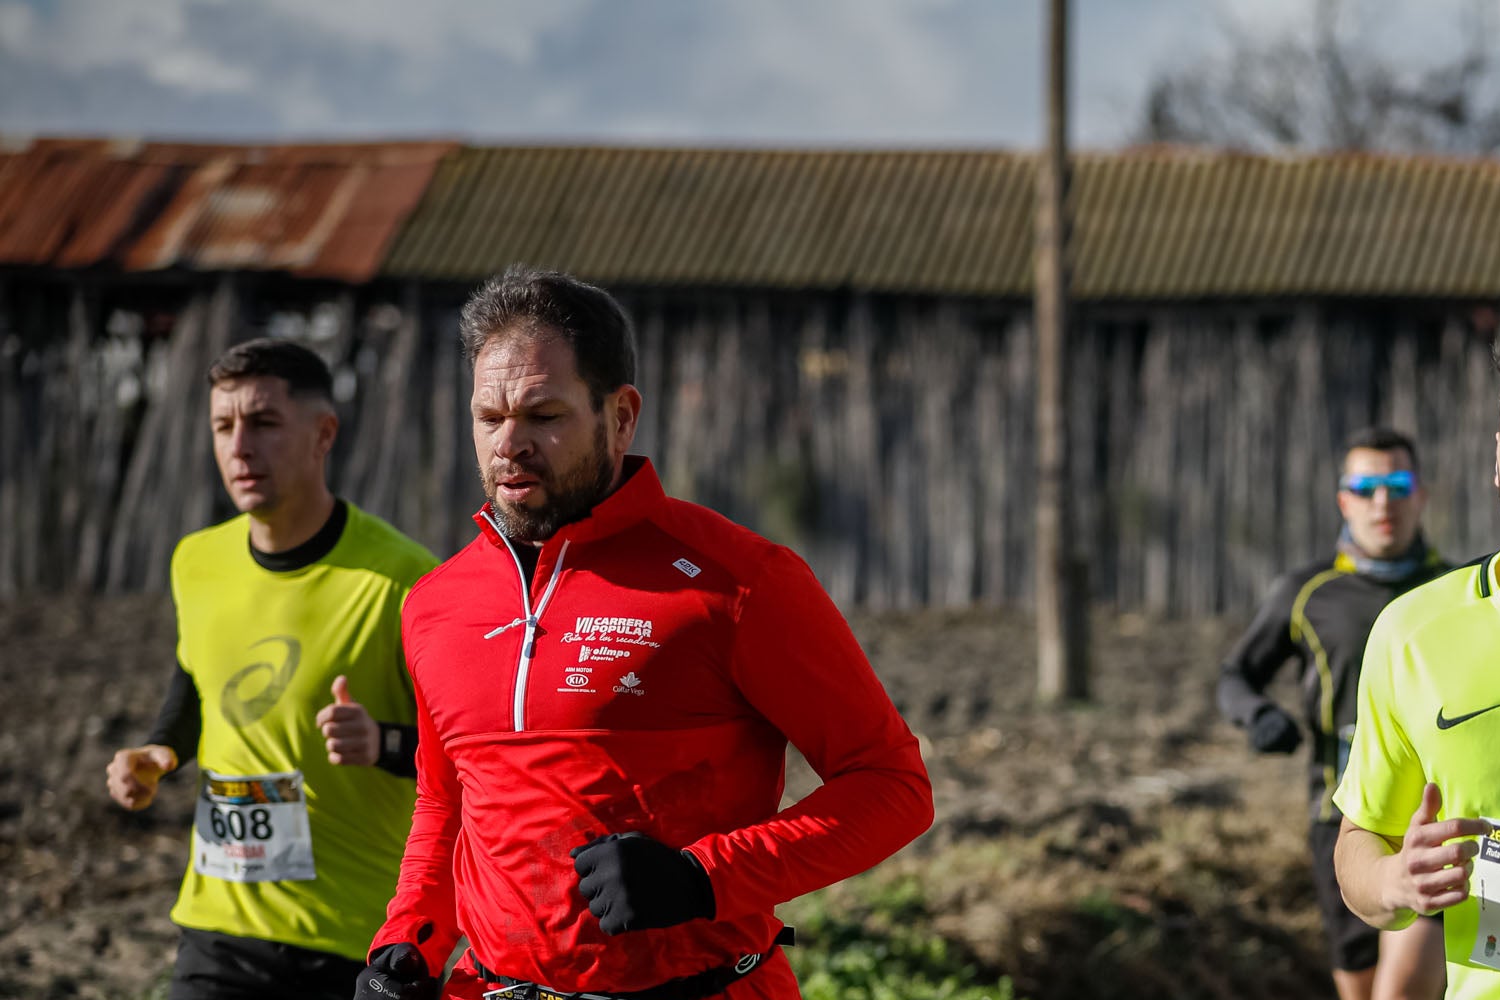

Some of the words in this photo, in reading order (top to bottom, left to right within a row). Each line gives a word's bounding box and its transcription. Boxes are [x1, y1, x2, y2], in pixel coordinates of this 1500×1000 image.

[575, 617, 594, 633] VII
[594, 617, 652, 630] CARRERA
[591, 625, 651, 637] POPULAR
[560, 632, 583, 643] Ruta
[585, 632, 597, 641] de
[599, 632, 613, 642] los
[616, 636, 660, 648] secaderos
[592, 647, 630, 658] olimpo
[569, 676, 584, 684] KIA
[210, 806, 273, 841] 608
[1485, 847, 1500, 857] Ruta
